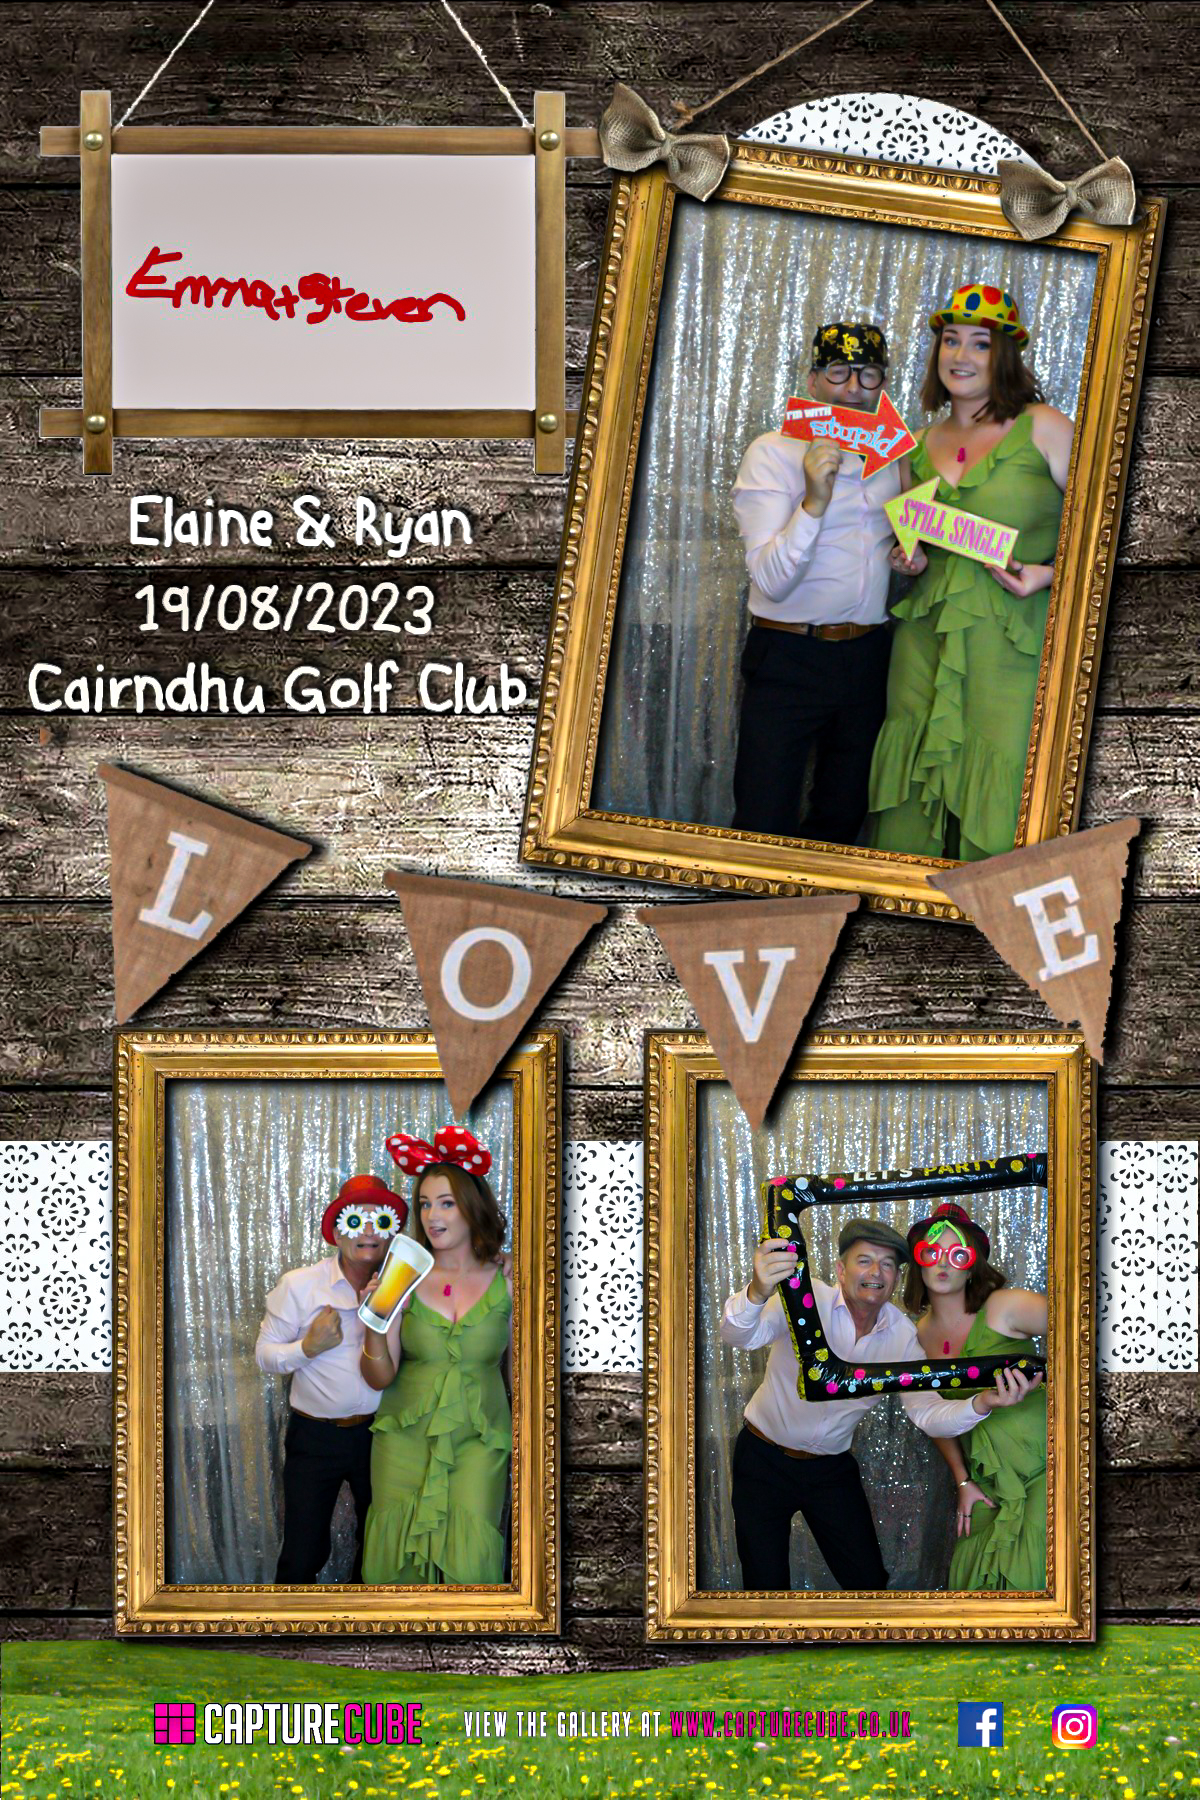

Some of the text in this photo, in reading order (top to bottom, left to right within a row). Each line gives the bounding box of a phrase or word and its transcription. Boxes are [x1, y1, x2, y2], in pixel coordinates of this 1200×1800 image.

[899, 498, 1011, 562] STILL SINGLE
[853, 1157, 999, 1182] LETS PARTY
